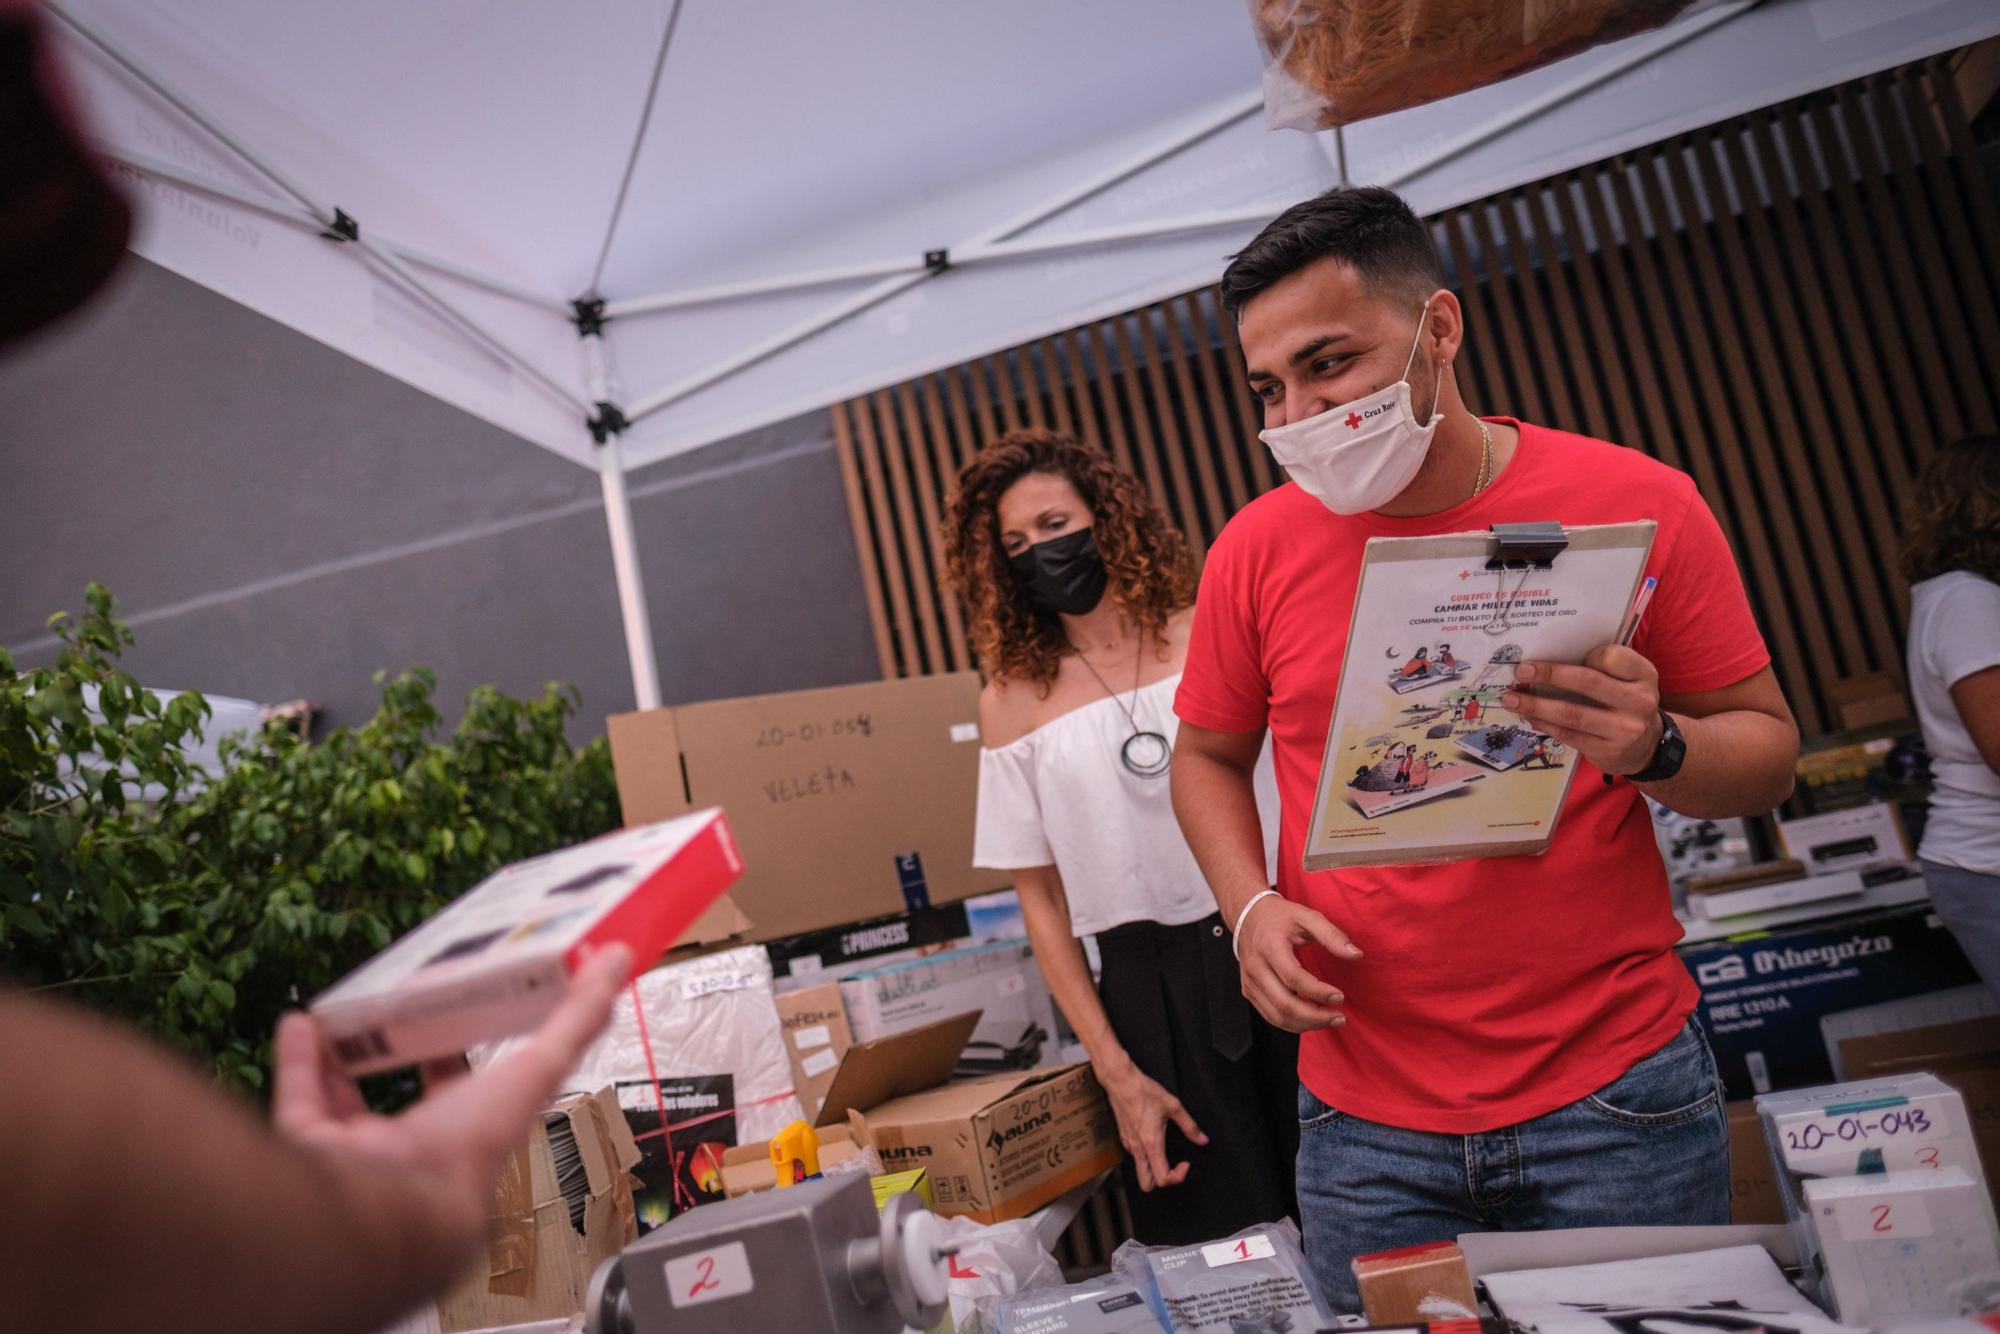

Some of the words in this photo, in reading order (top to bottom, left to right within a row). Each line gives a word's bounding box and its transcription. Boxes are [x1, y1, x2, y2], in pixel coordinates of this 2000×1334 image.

[1364, 409, 1382, 418] Cruz
[1434, 602, 1478, 613] CAMBIAR
[1481, 600, 1511, 610] MILES
[1514, 599, 1527, 608] DE
[1530, 598, 1558, 607] VIDAS
[1451, 591, 1491, 602] CONTIGO
[1510, 588, 1551, 599] POSIBLE
[1409, 617, 1445, 626] COMPRA
[1459, 613, 1491, 622] BOLETO
[1510, 610, 1544, 619] SORTEO
[1558, 608, 1577, 617] ORO
[762, 761, 856, 802] VELETA
[851, 923, 910, 954] PRINCESS
[1003, 1112, 1053, 1142] auna
[1787, 1108, 1932, 1150] 20-01-043
[1871, 1203, 1893, 1232] 2
[1233, 1239, 1254, 1260] 1
[1164, 1259, 1187, 1270] CLIP
[688, 1255, 721, 1299] 2
[1196, 1300, 1217, 1310] plastic
[1219, 1296, 1232, 1304] bag
[1233, 1292, 1250, 1301] away
[1251, 1288, 1267, 1297] from
[1290, 1281, 1303, 1290] and
[1209, 1288, 1227, 1297] avoid
[1228, 1283, 1250, 1294] danger
[1198, 1310, 1208, 1318] Do
[1210, 1307, 1220, 1315] not
[1221, 1305, 1233, 1313] use
[1234, 1301, 1247, 1309] this
[1248, 1298, 1260, 1306] bag
[1213, 1315, 1227, 1324] play
[1284, 1300, 1295, 1308] not
